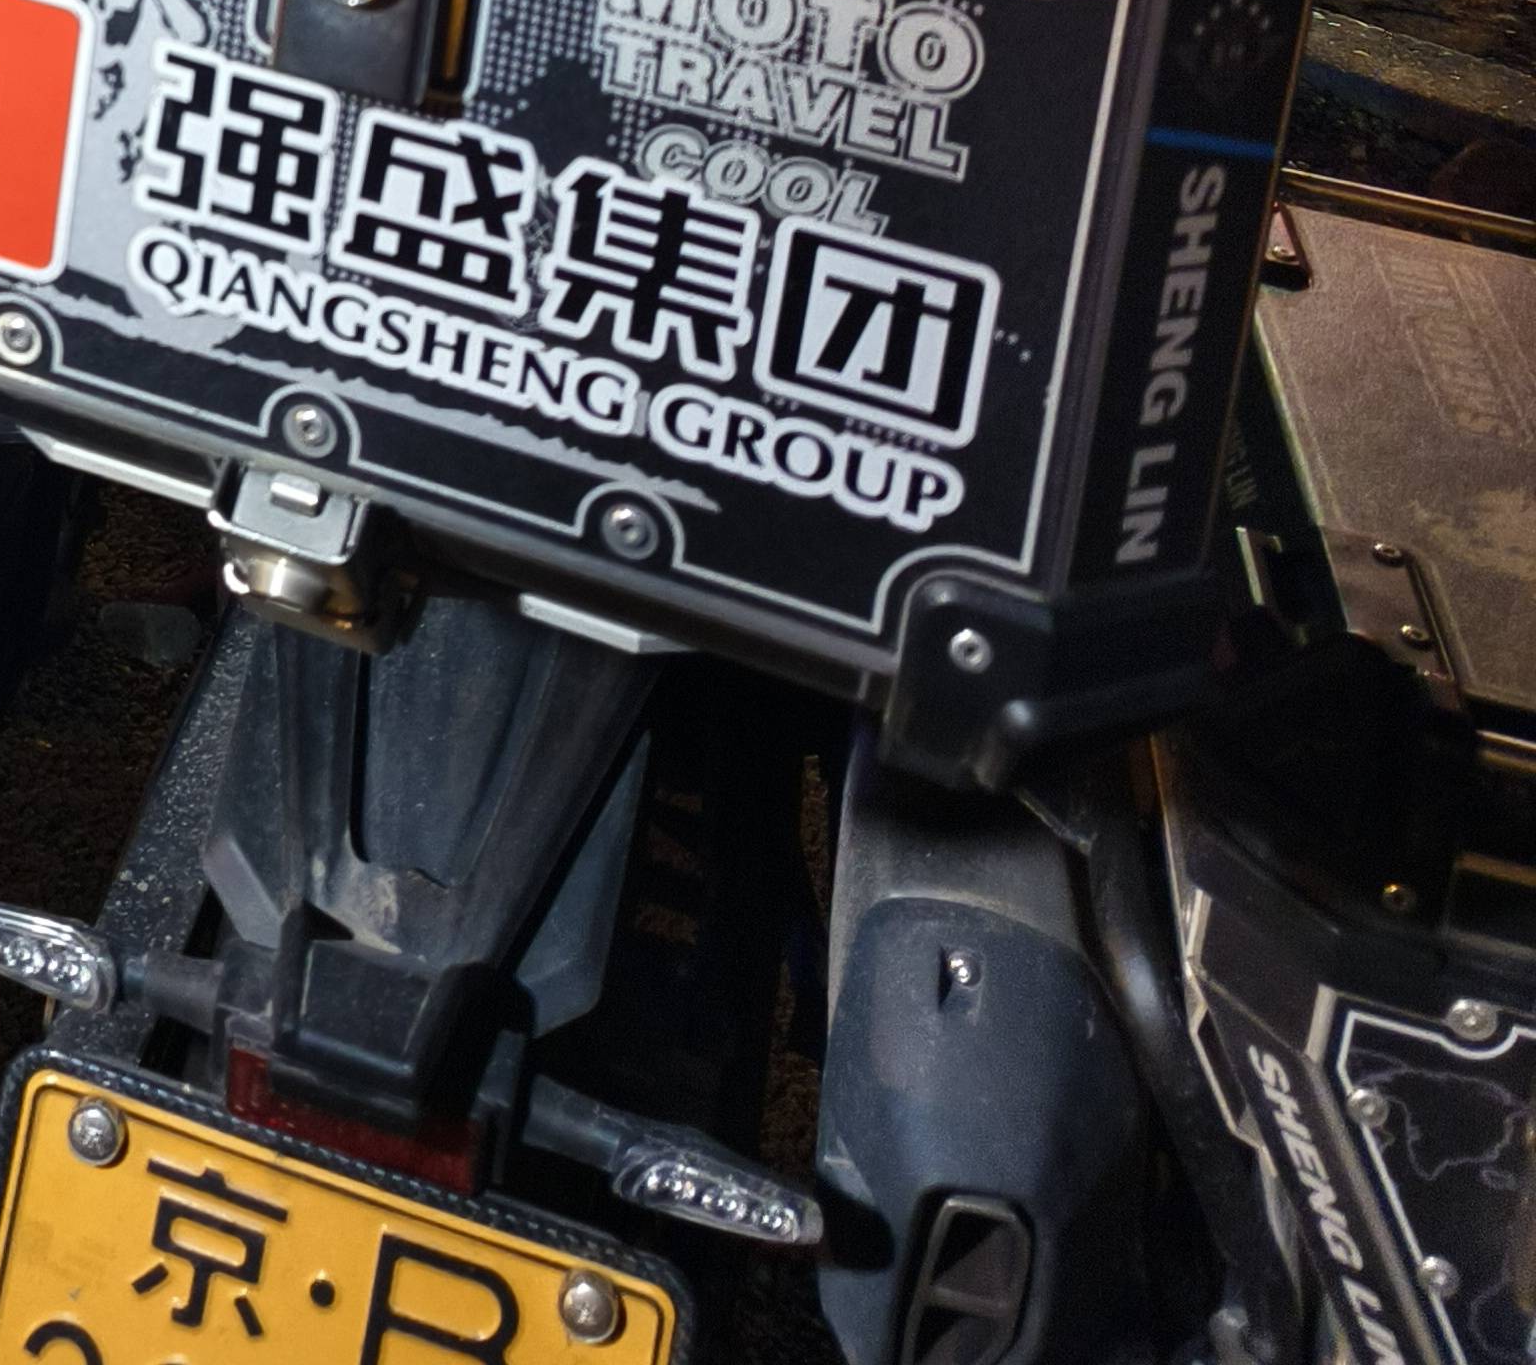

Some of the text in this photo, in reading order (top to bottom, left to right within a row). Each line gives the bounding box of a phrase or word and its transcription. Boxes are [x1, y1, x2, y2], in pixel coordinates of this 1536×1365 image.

[602, 24, 967, 179] TRAVEL
[638, 124, 889, 239] COOL
[146, 50, 993, 441] 强盛集团
[1114, 165, 1227, 565] SHENG LIN
[140, 239, 954, 522] QIANGSHENG GROUP
[1248, 1044, 1364, 1271] SHENG
